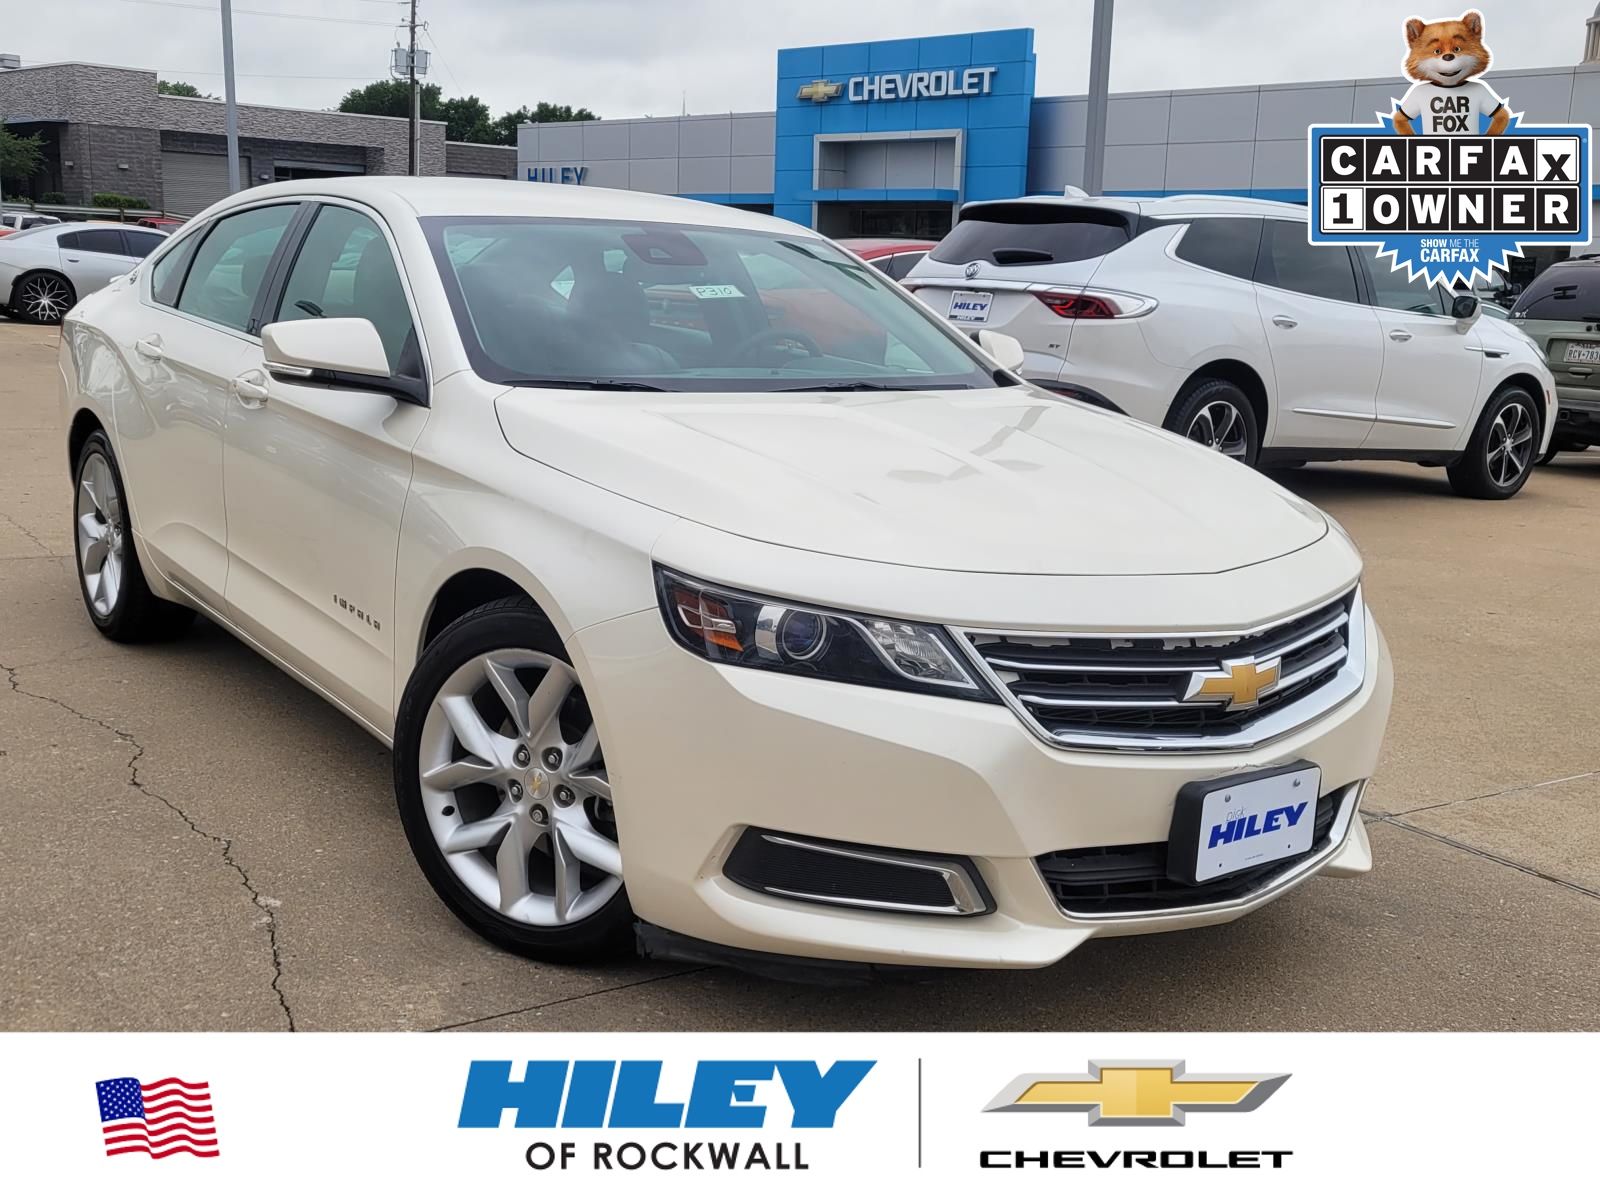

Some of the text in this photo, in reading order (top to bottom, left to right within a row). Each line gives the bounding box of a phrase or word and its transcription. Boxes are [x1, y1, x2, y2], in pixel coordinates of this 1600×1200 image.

[849, 66, 997, 101] CHEVROLET
[953, 302, 988, 311] HILEY
[1208, 801, 1309, 849] HILEY
